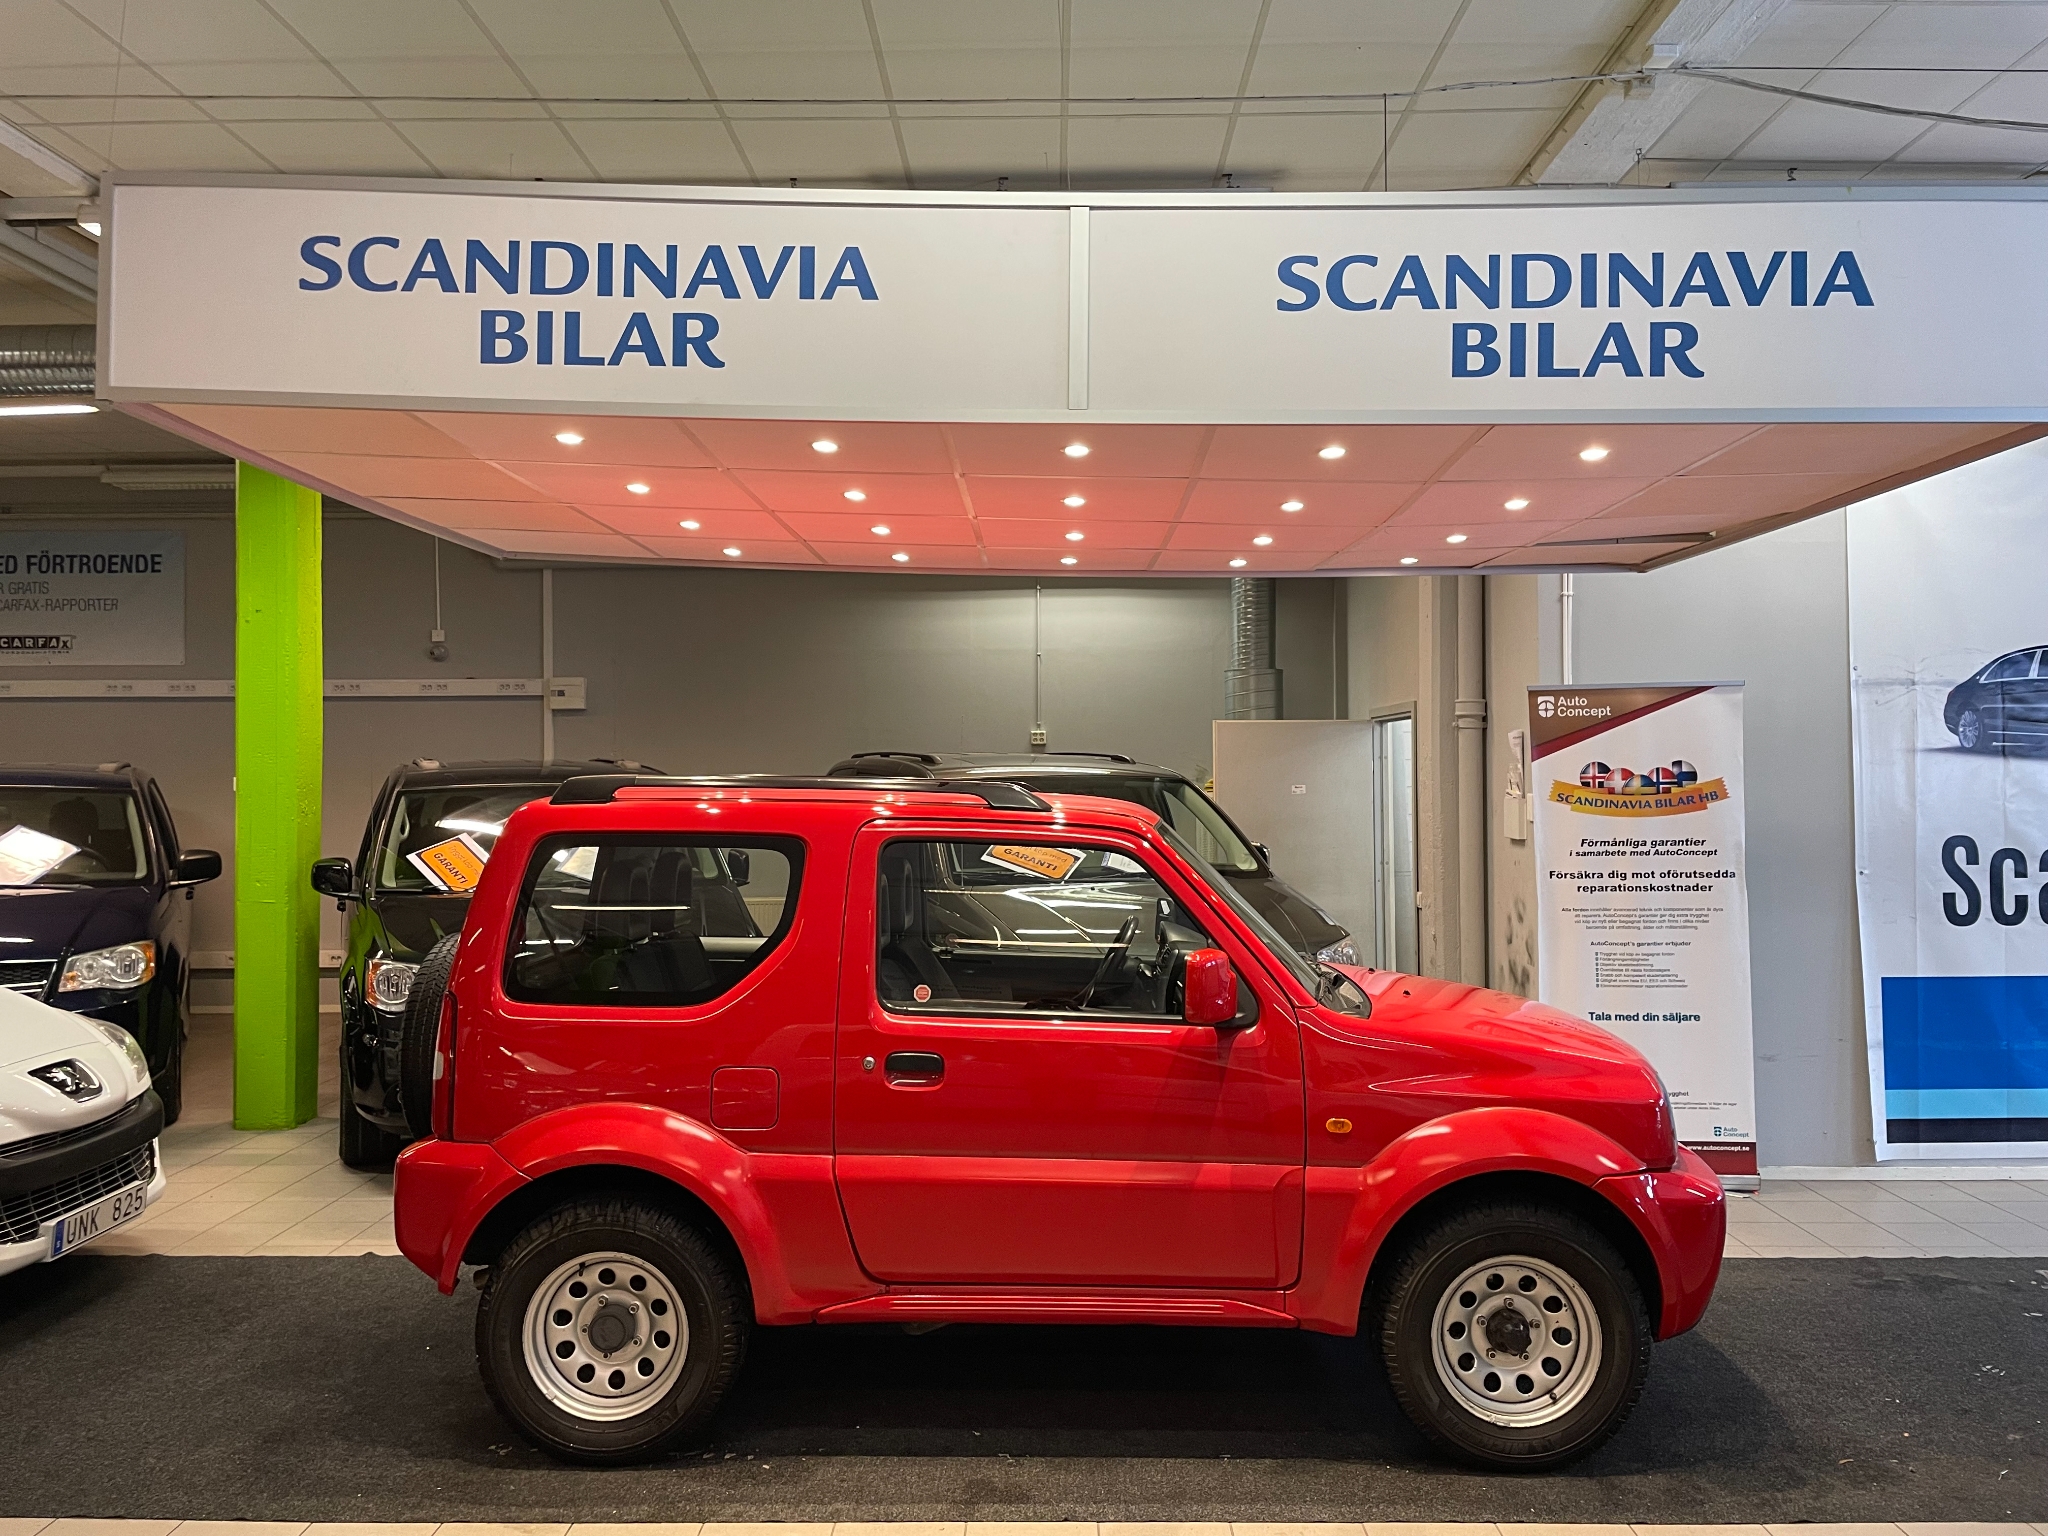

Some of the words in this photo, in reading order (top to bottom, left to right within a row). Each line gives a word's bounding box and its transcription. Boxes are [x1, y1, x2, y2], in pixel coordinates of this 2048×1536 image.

[299, 235, 879, 301] SCANDINAVIA
[1276, 250, 1875, 312] SCANDINAVIA
[480, 310, 725, 368] BILAR
[1451, 321, 1705, 378] BILAR
[26, 550, 163, 574] FÖRTROENDE
[8, 581, 50, 594] GRATIS
[0, 636, 71, 649] CARFAX
[1557, 696, 1588, 706] Auto
[1557, 707, 1612, 718] Concept
[1556, 793, 1652, 809] SCANDINAVIA
[1655, 795, 1695, 809] BILAR
[1699, 791, 1719, 803] HB
[1580, 838, 1647, 849] Förmånliga
[1650, 838, 1706, 848] garantier
[1003, 848, 1058, 871] GARANTI
[1575, 849, 1627, 857] samarbete
[1629, 849, 1651, 857] med
[1653, 849, 1718, 857] AutoConcept
[434, 852, 469, 884] GARANTI
[1549, 871, 1604, 880] Försäkra
[1607, 870, 1628, 881] dig
[1631, 871, 1656, 879] mot
[1659, 870, 1736, 879] oförutsedda
[1577, 883, 1714, 893] reparationskostnader
[1941, 835, 2048, 926] Sc
[1588, 1012, 1611, 1021] Tala
[1615, 1012, 1639, 1021] med
[1642, 1012, 1659, 1021] din
[1662, 1012, 1700, 1023] säljare
[67, 1206, 100, 1244] UNK
[113, 1187, 144, 1222] 825
